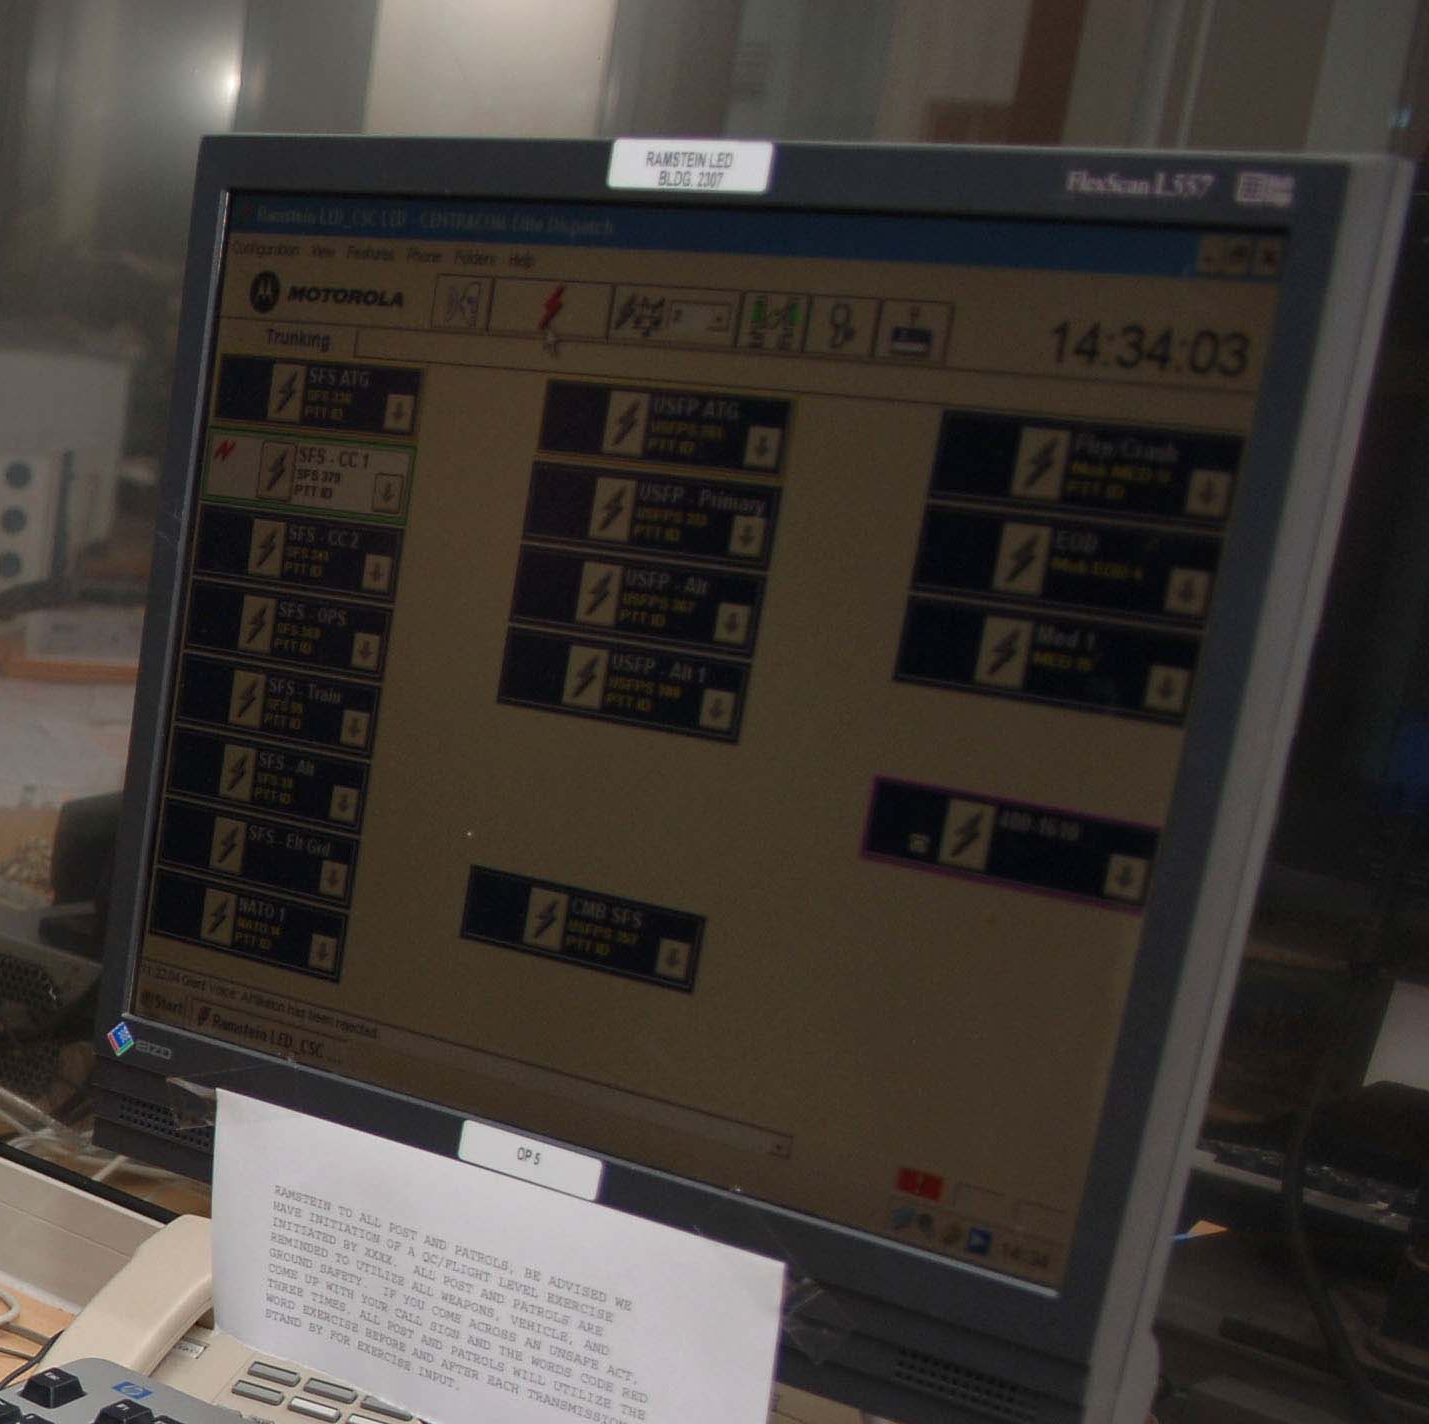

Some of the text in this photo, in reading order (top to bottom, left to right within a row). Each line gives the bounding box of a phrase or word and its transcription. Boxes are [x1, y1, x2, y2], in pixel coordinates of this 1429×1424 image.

[646, 151, 733, 168] RAMSTEIN LED
[658, 170, 724, 188] BLDG. 2307
[1065, 170, 1216, 199] FlexScan L557
[547, 217, 614, 236] Dispatch
[233, 242, 301, 258] Configuration
[347, 246, 395, 262] Features
[407, 249, 441, 263] Phone
[454, 252, 496, 265] Folders
[508, 253, 535, 269] Help
[287, 288, 403, 308] MOTOROLA
[267, 329, 331, 352] Trunking
[1052, 319, 1250, 376] 14:34:03
[309, 368, 339, 385] SFS
[297, 446, 370, 468] SFS CC 1
[297, 469, 318, 481] SFS
[294, 485, 333, 498] PTT ID
[289, 526, 360, 548] SFS CC 2
[278, 603, 347, 626] SFS OPS
[268, 677, 341, 705] SFS Train
[259, 752, 315, 777] SFS Alt
[248, 825, 273, 843] SFS
[240, 896, 275, 917] NATO
[613, 907, 644, 927] SFS
[156, 994, 183, 1015] Start
[212, 1013, 267, 1042] Ramstein
[135, 1039, 173, 1060] EIZO
[517, 1147, 541, 1165] OP 5
[274, 1185, 331, 1212] RAMSTEIN
[338, 1205, 352, 1219] TO
[360, 1212, 381, 1228] ALL
[388, 1222, 417, 1240] POST
[424, 1234, 446, 1250] AND
[524, 1267, 539, 1281] BE
[548, 1275, 607, 1302] ADVISED
[617, 1296, 634, 1310] WE
[273, 1201, 301, 1219] HAVE
[309, 1212, 379, 1245] INITIATION
[387, 1238, 401, 1252] OF
[408, 1246, 415, 1257] A
[498, 1276, 537, 1298] LEVEL
[546, 1292, 614, 1322] EXERCISE
[272, 1216, 335, 1246] INITIATED
[343, 1240, 356, 1253] BY
[414, 1264, 435, 1281] ALL
[443, 1275, 472, 1293] POST
[481, 1287, 503, 1304] AND
[512, 1298, 568, 1325] PATROLS
[577, 1320, 603, 1336] ARE
[271, 1232, 609, 1356] REMINDED TO UTILIZE ALL AND
[270, 1247, 311, 1270] GROUND
[382, 1286, 396, 1300] IF
[403, 1294, 425, 1310] YOU
[432, 1304, 461, 1323] COME
[469, 1318, 515, 1342] ACROSS
[524, 1337, 539, 1350] AN
[548, 1345, 598, 1370] UNSAFE
[265, 1308, 300, 1329] STAND
[307, 1323, 320, 1337] BY
[328, 1331, 348, 1347] FOR
[356, 1341, 411, 1371] EXERCISE
[266, 1293, 294, 1312] WORD
[301, 1305, 356, 1334] EXERCISE
[364, 1328, 406, 1353] BEFORE
[413, 1347, 434, 1363] AND
[442, 1358, 479, 1380] AFTER
[487, 1374, 517, 1394] EACH
[269, 1263, 651, 1404] COME UP WITH YOUR CALL SIGN AND THE WORDS CODE RED
[268, 1278, 302, 1299] THREE
[358, 1310, 379, 1327] ALL
[386, 1321, 414, 1340] POST
[422, 1334, 443, 1350] AND
[451, 1344, 504, 1372] PATROLS
[512, 1366, 543, 1386] WILL
[552, 1381, 612, 1409] UTILIZE
[621, 1404, 649, 1421] THE
